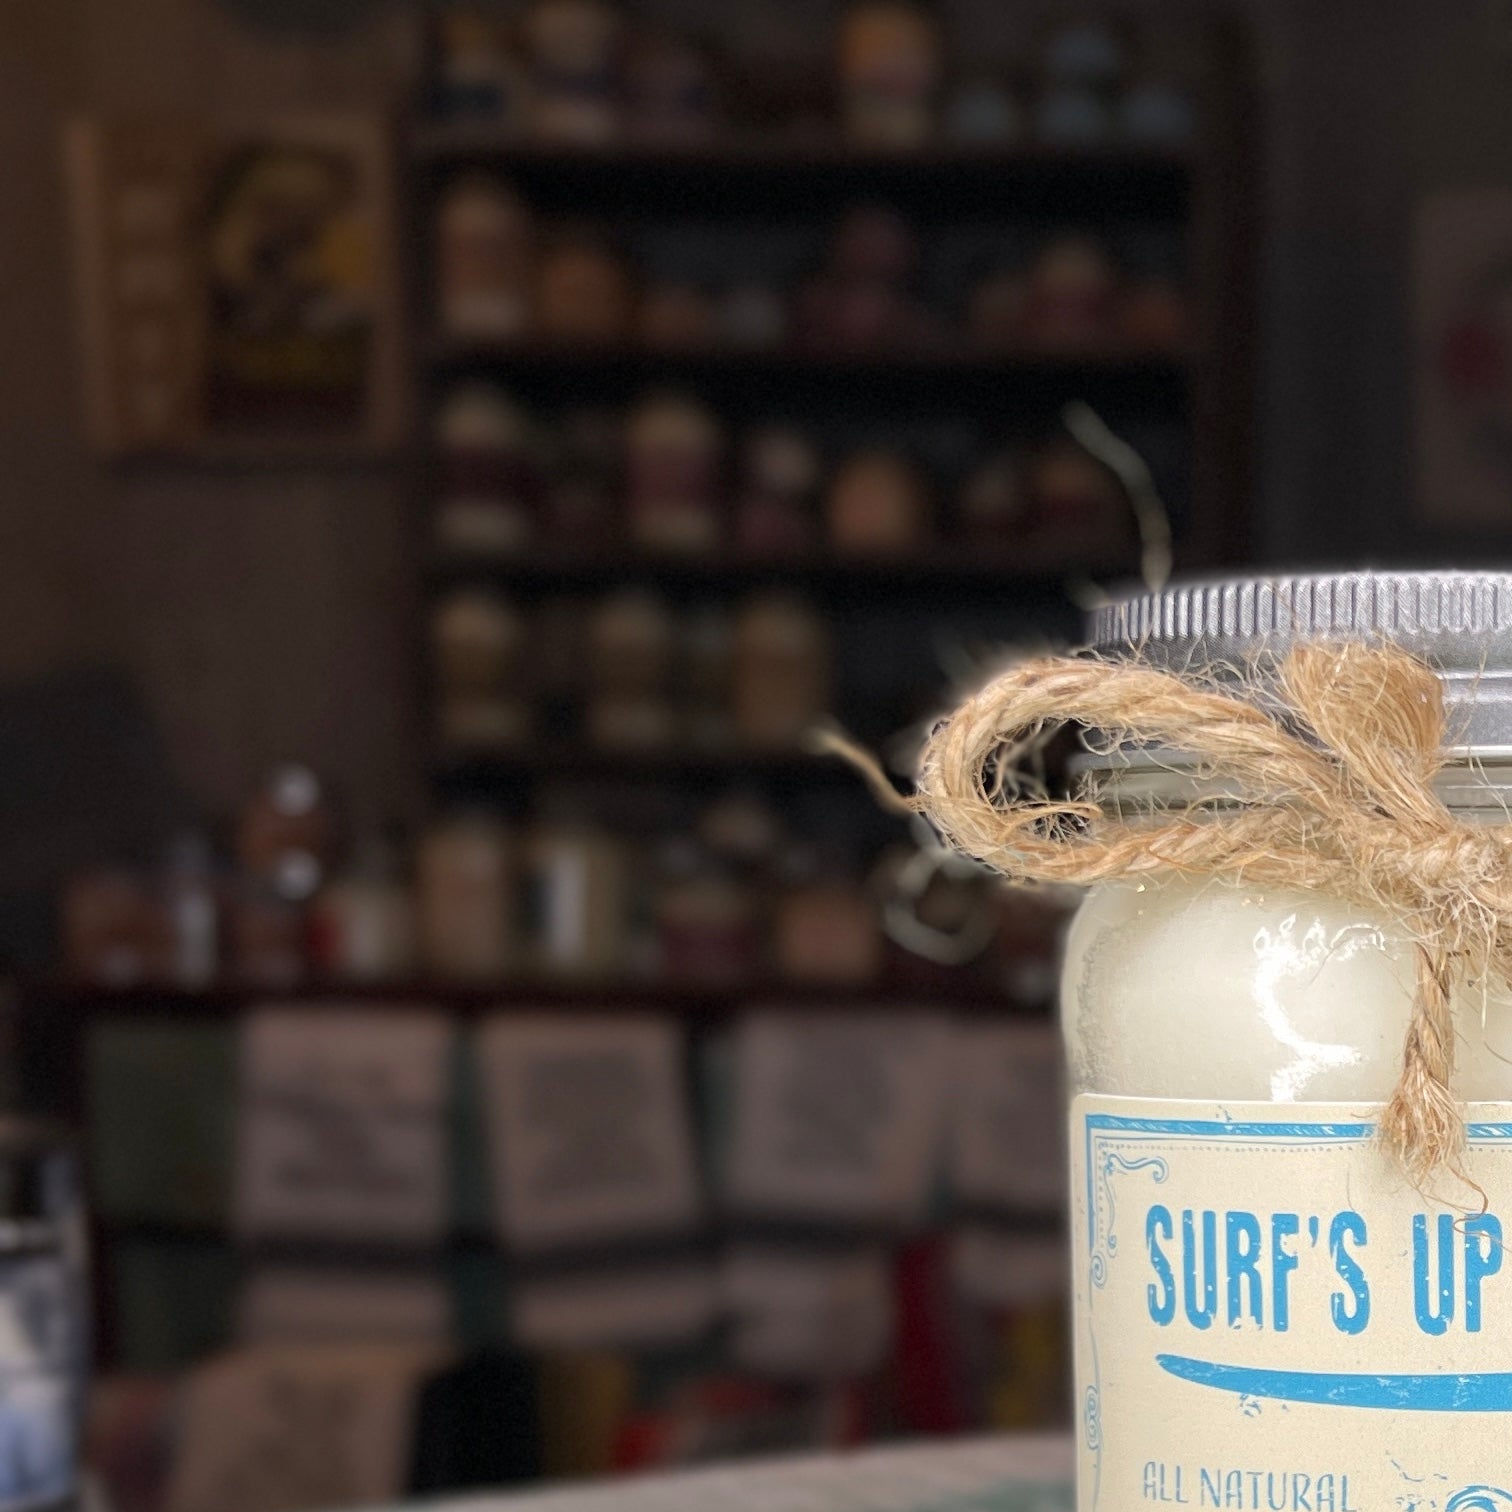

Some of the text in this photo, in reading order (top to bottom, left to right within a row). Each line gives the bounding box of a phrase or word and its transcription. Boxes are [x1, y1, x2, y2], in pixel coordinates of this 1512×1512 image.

[1145, 1203, 1371, 1335] SURF'S
[1411, 1212, 1504, 1335] UP
[1143, 1461, 1189, 1503] ALL
